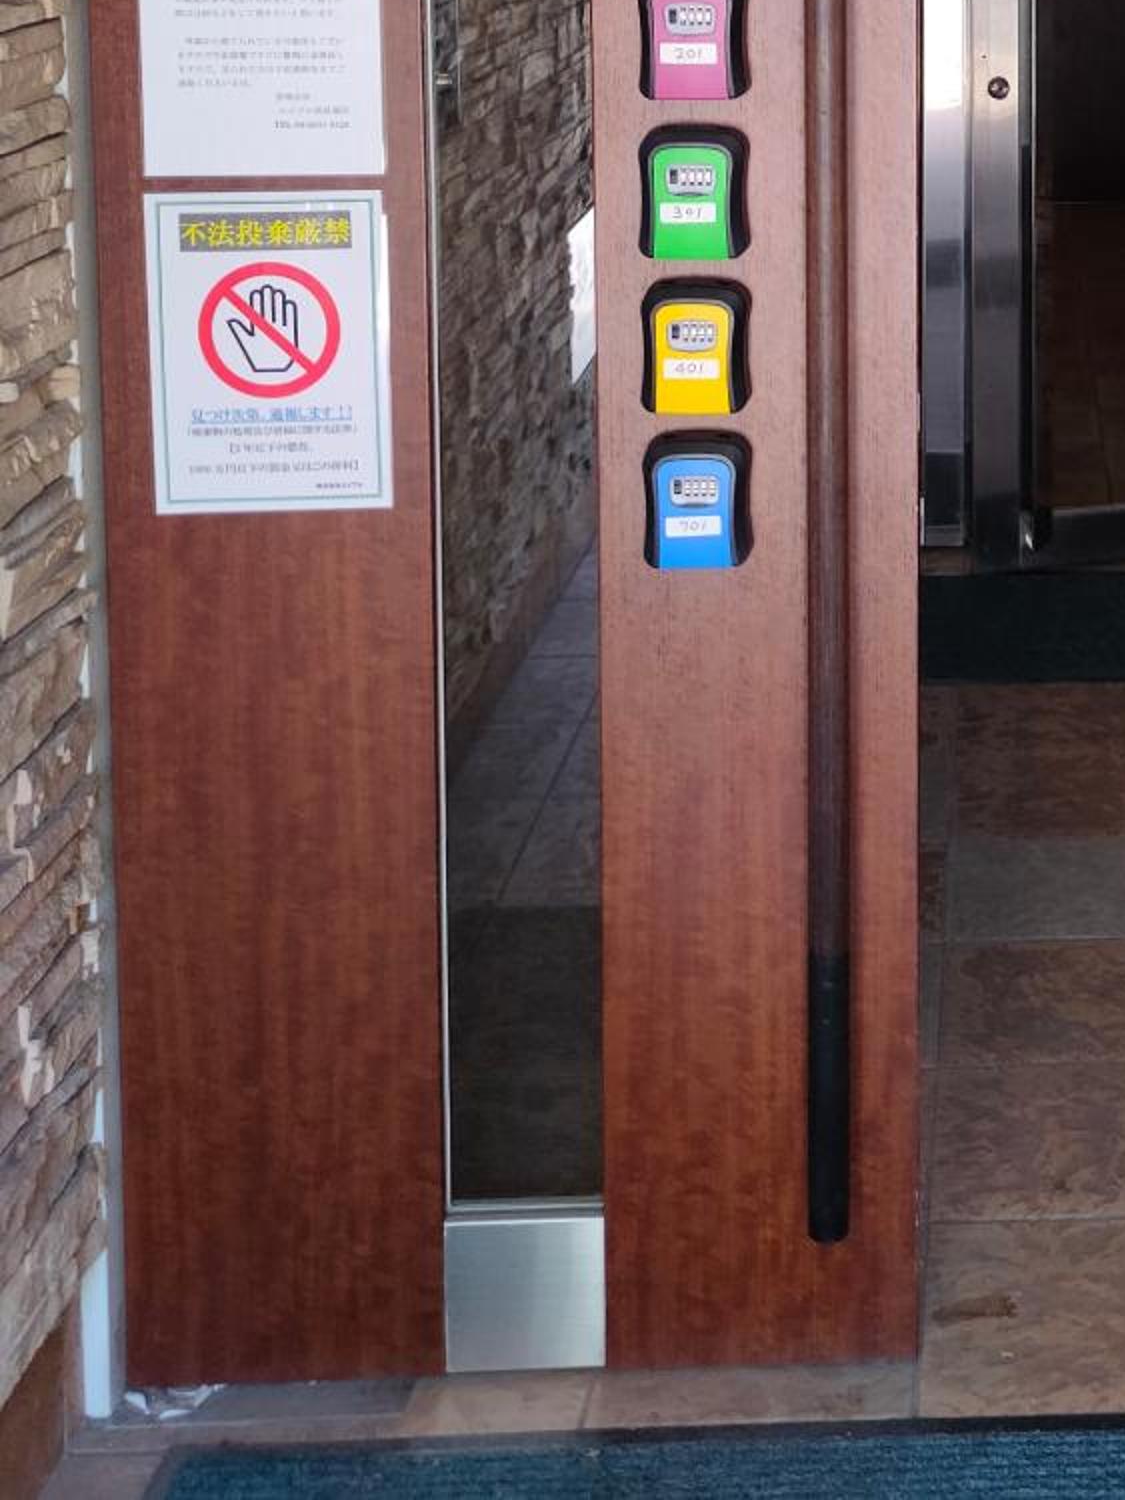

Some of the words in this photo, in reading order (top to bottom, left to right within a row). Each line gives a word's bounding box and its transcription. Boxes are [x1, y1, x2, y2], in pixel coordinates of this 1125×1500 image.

[673, 47, 703, 60] 201
[672, 205, 702, 219] 301
[180, 218, 350, 246] 不法投棄厳禁
